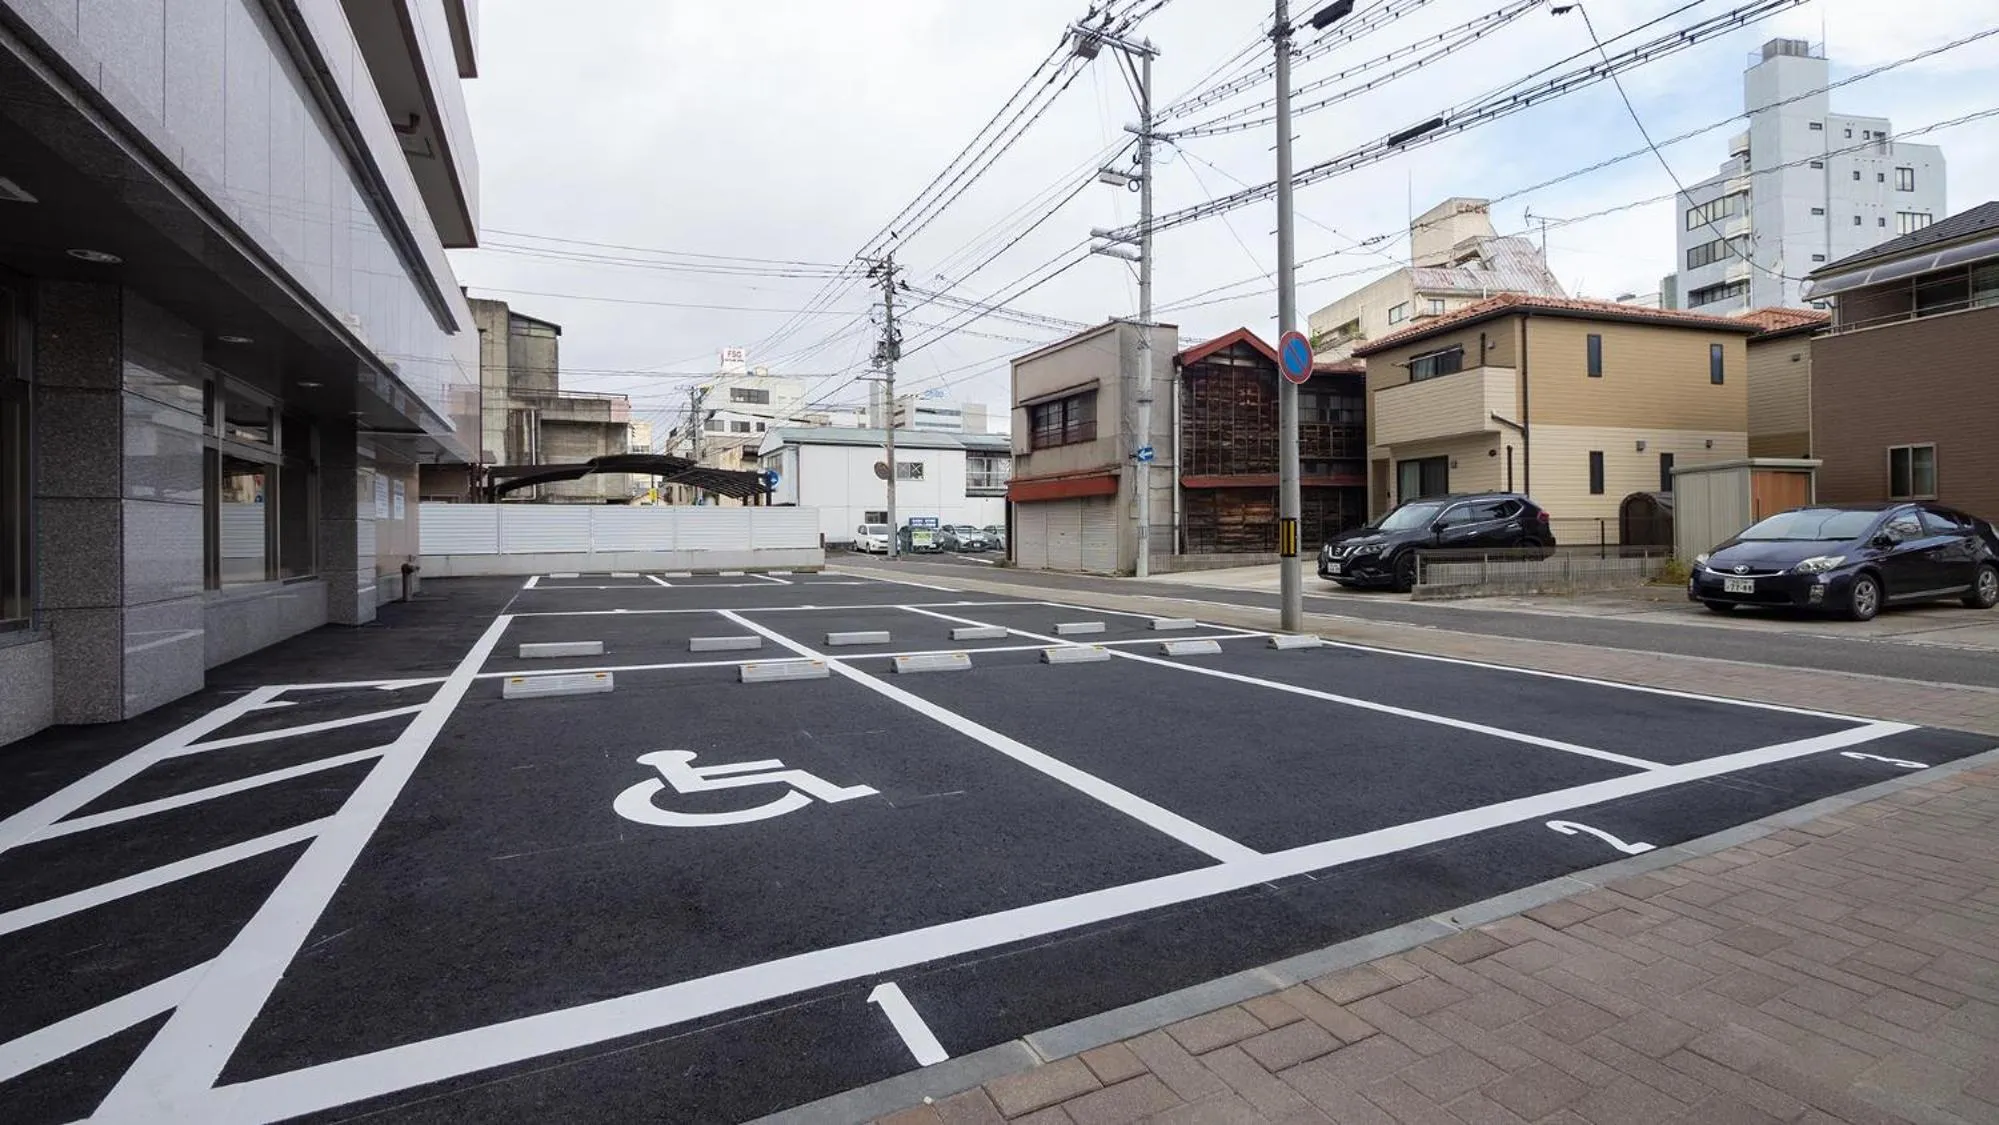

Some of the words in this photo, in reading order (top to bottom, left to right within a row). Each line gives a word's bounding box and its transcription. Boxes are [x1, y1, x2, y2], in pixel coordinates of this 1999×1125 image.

[1840, 751, 1930, 769] 3
[1545, 820, 1657, 855] 2
[867, 981, 949, 1067] 1
